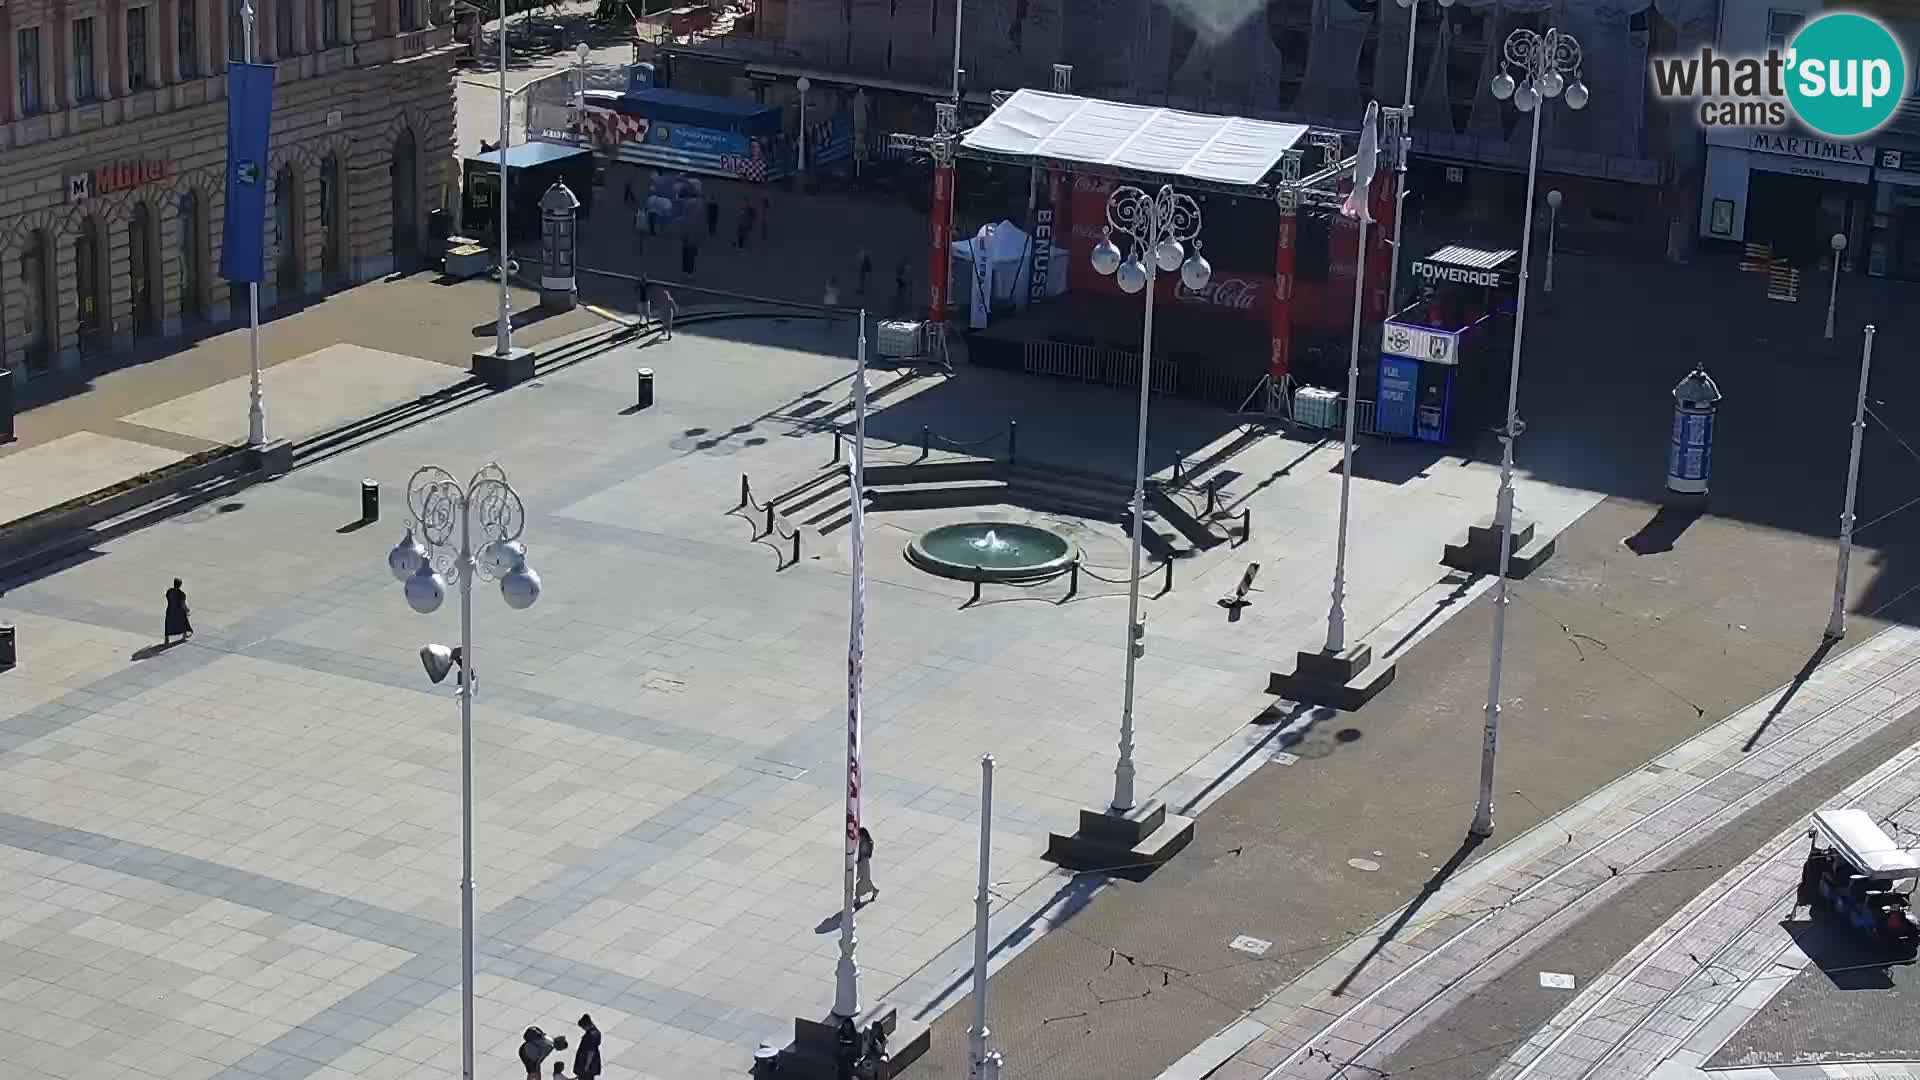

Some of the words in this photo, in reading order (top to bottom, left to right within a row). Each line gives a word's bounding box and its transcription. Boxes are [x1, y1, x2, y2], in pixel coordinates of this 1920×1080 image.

[1753, 133, 1866, 162] MARTIMEX
[1031, 208, 1052, 304] BENUSSI
[1411, 261, 1501, 288] POWERADE
